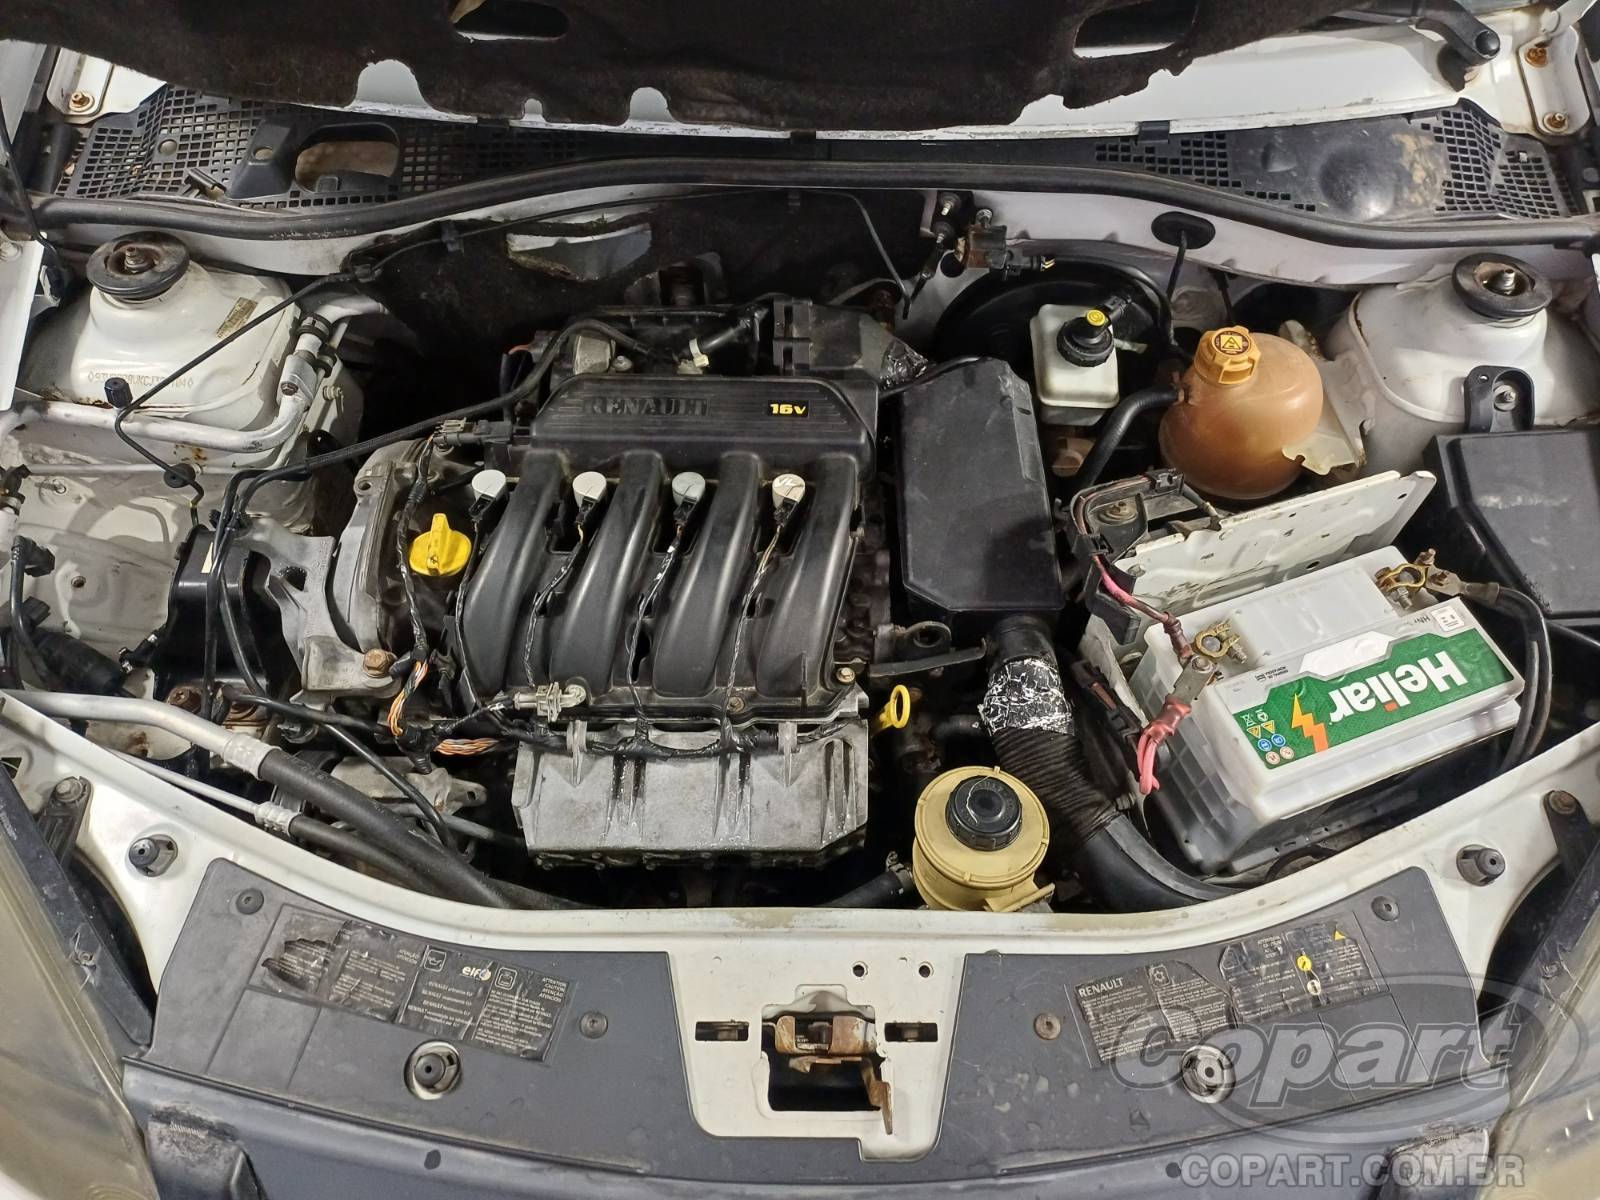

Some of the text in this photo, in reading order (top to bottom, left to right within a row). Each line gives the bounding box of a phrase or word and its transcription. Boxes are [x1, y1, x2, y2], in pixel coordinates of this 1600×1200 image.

[584, 397, 708, 416] RENAULT
[1330, 651, 1467, 722] Heliar
[1078, 977, 1124, 997] RENAULT
